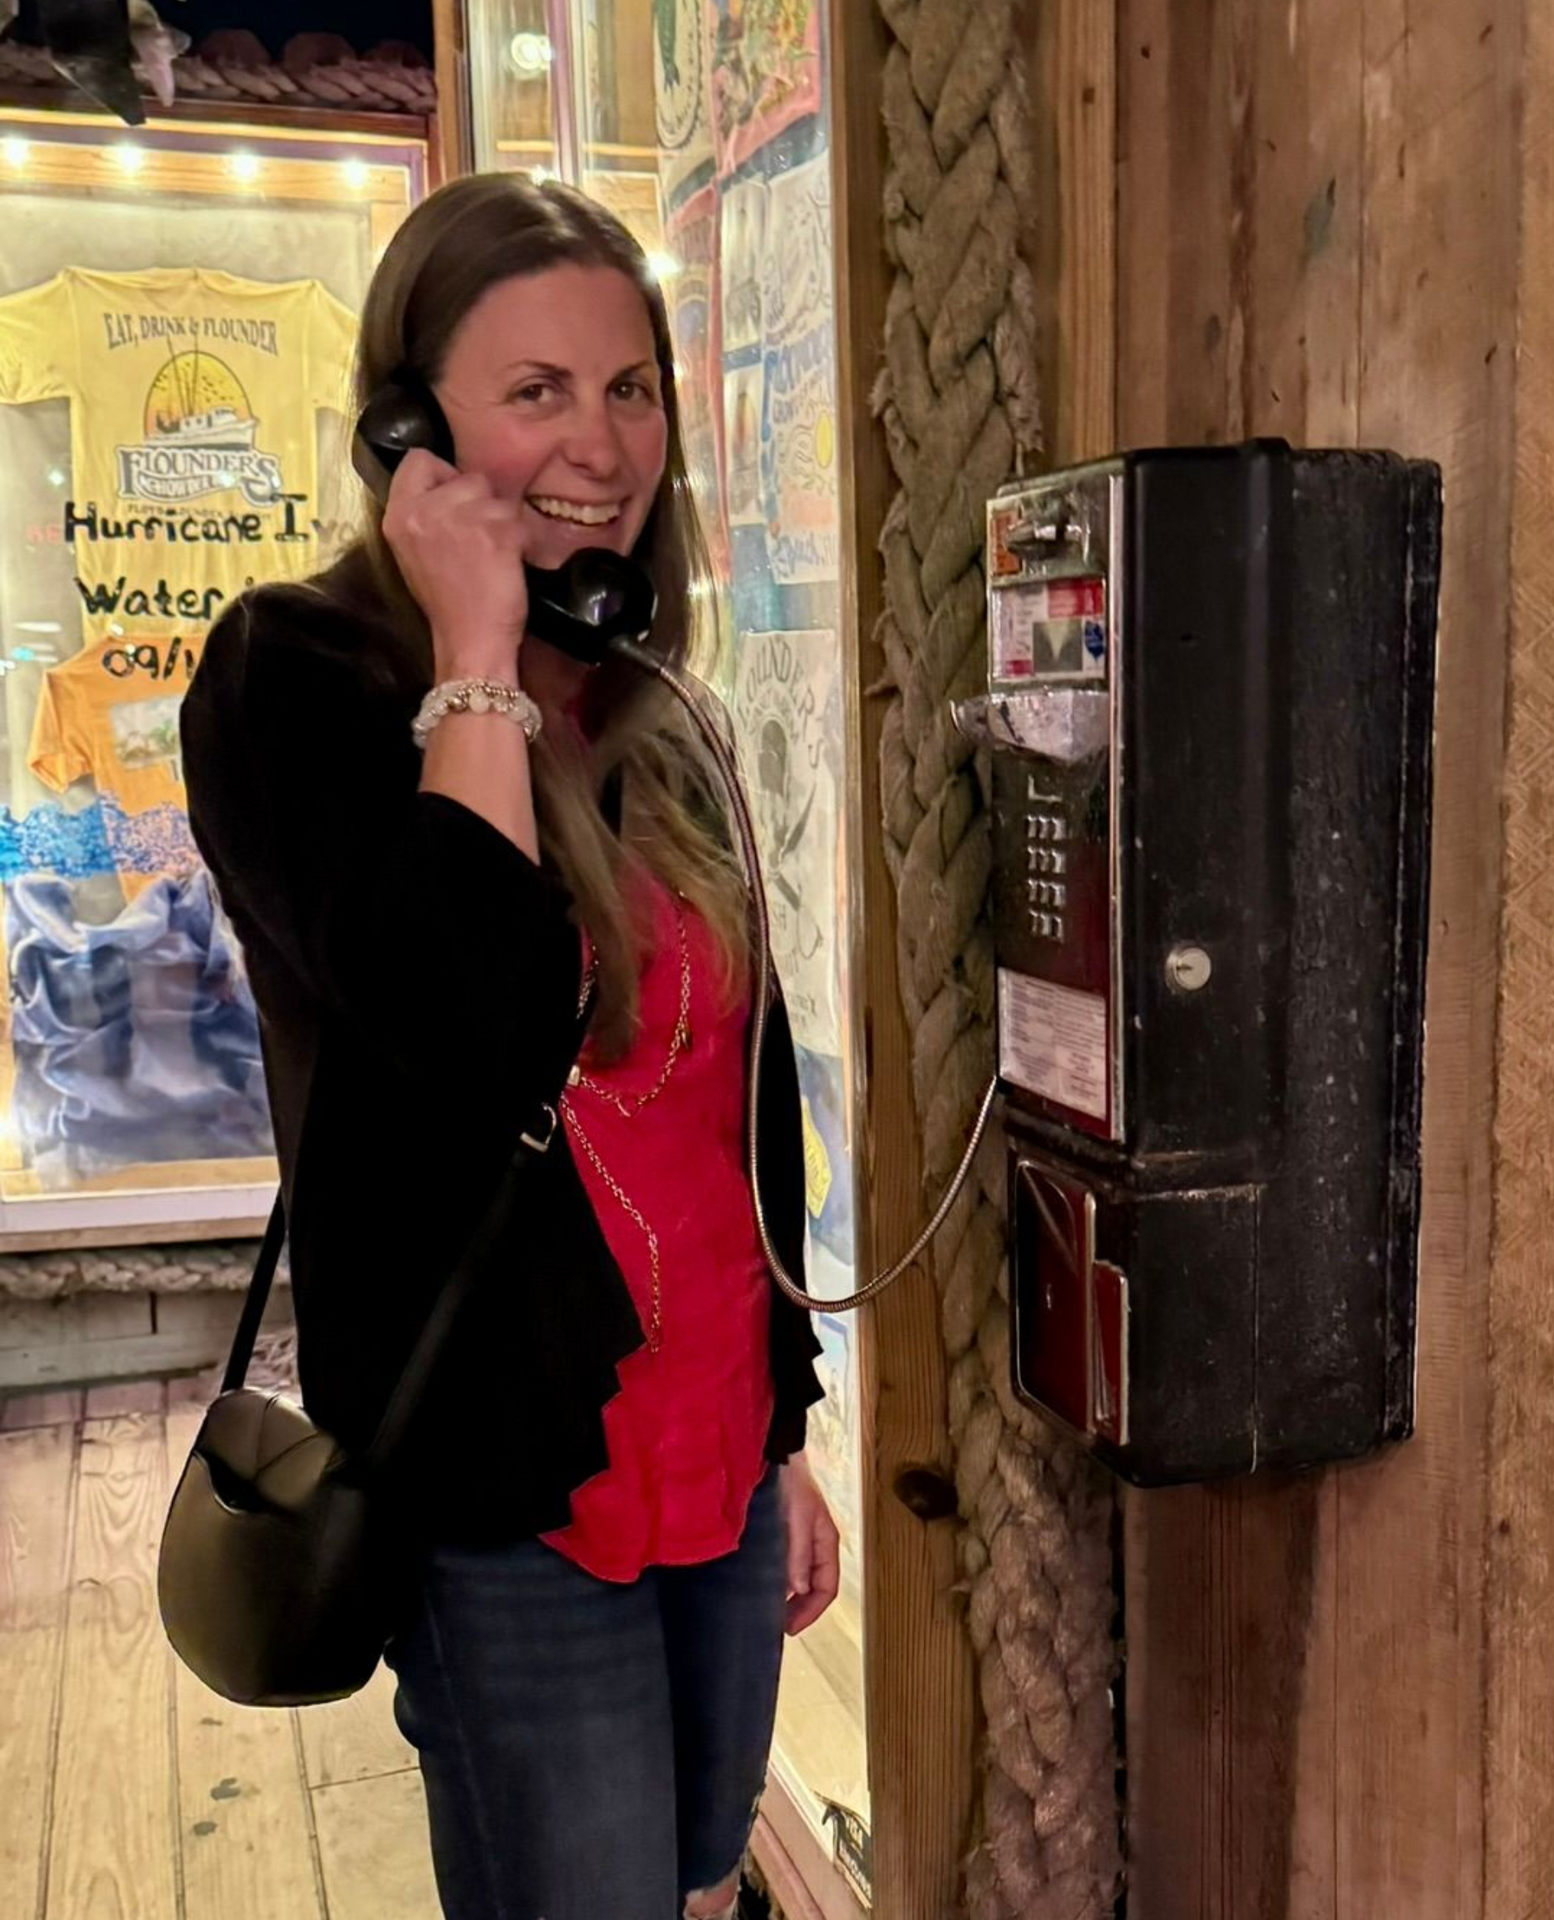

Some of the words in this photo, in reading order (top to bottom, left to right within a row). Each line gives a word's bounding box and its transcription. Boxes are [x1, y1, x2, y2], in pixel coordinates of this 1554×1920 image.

[103, 313, 139, 350] EAT,
[139, 315, 187, 340] DRINK
[189, 317, 199, 336] &
[203, 317, 279, 356] FLOUNDER
[120, 450, 281, 503] FLOUNDER'S
[65, 502, 262, 543] Hurricane
[73, 577, 223, 620] Water
[102, 636, 196, 682] 09/1
